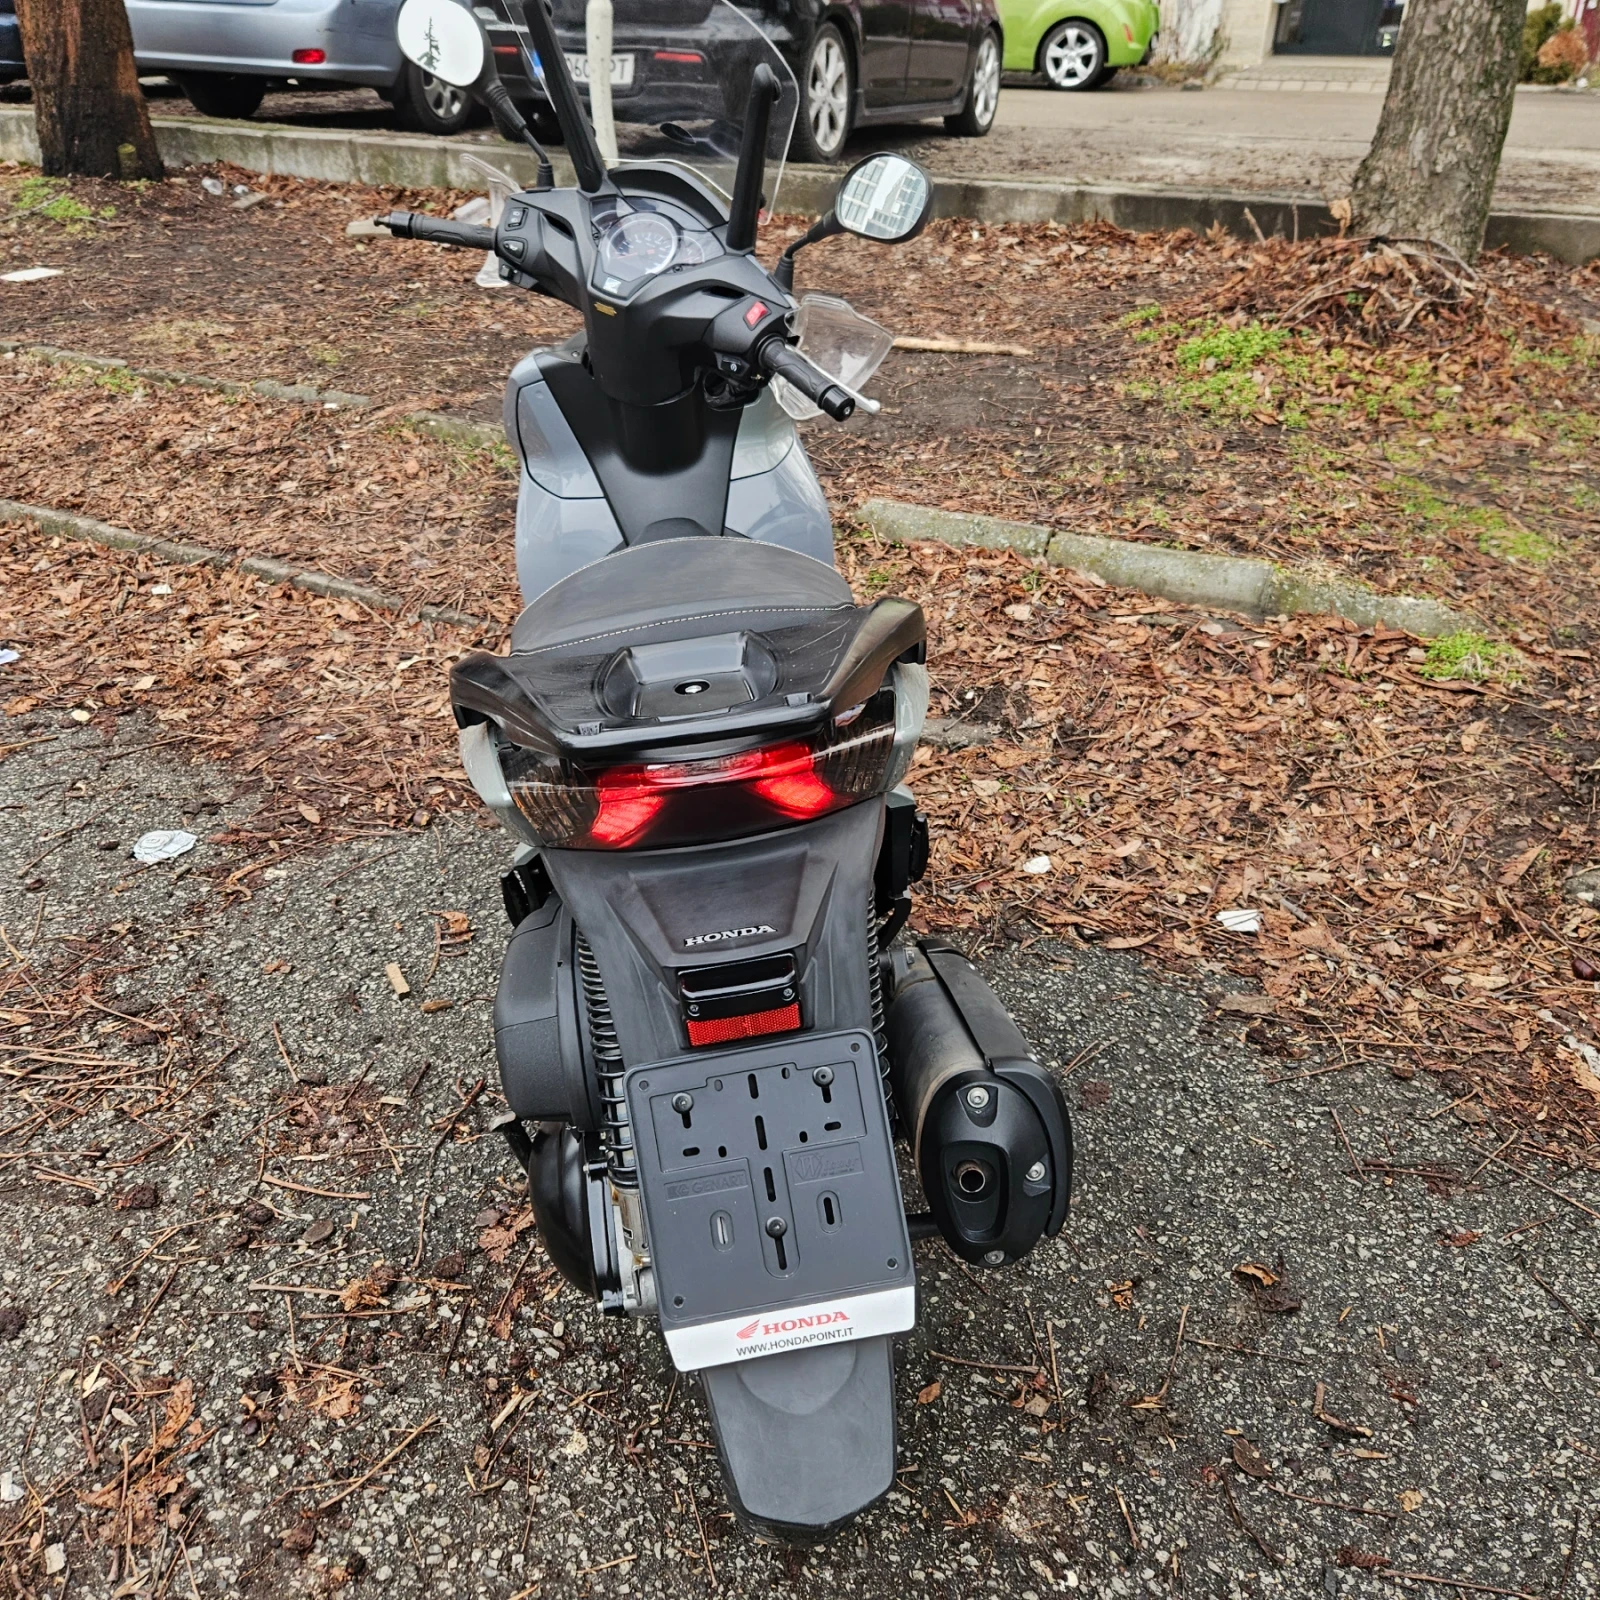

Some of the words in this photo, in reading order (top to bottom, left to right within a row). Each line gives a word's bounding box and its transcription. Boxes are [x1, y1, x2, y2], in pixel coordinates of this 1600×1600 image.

[684, 924, 777, 947] HONDA
[762, 1310, 850, 1336] HONDA
[736, 1327, 854, 1357] WWW.HONDAPOINT.IT
